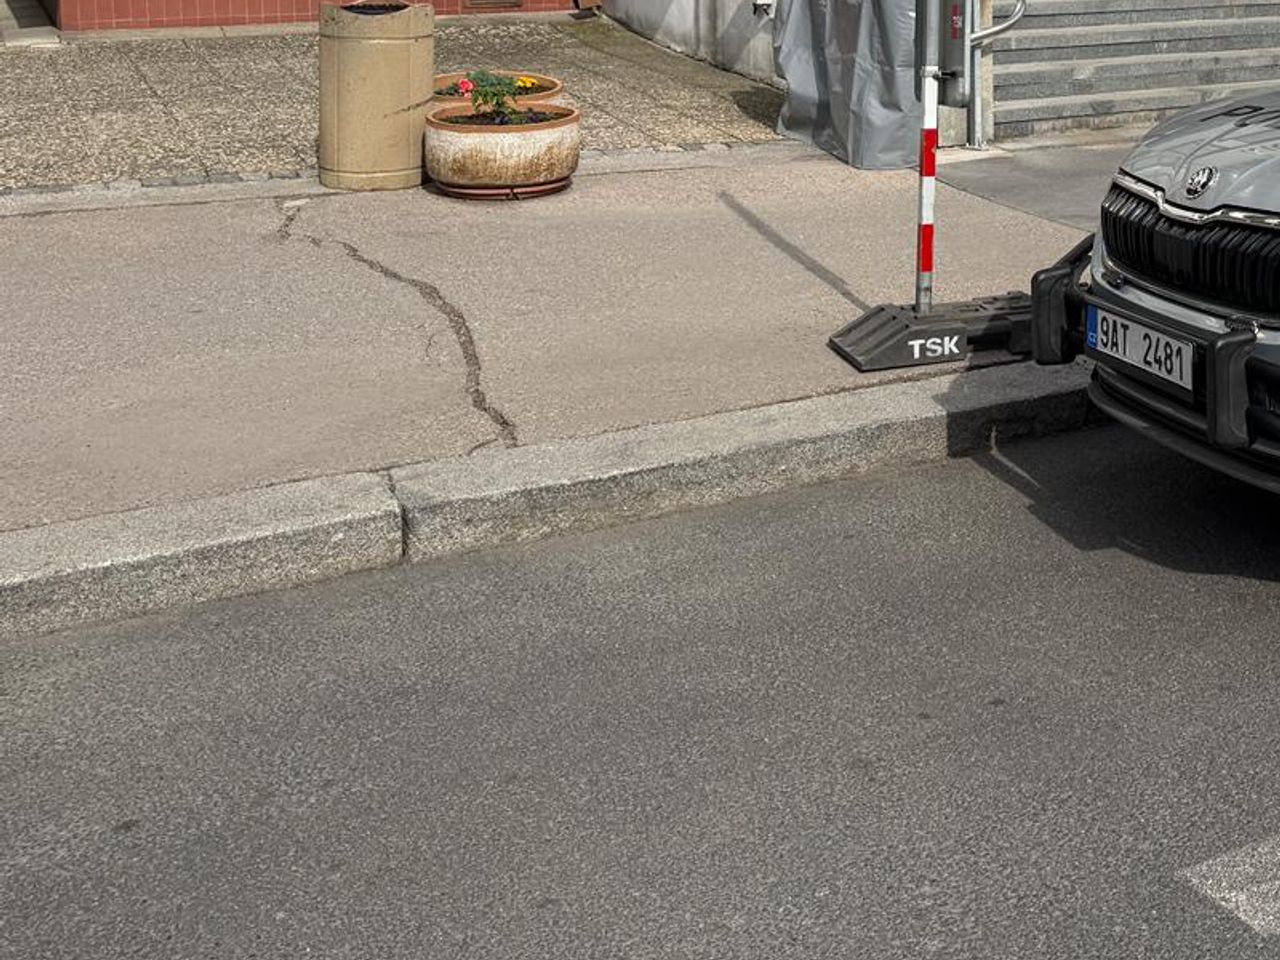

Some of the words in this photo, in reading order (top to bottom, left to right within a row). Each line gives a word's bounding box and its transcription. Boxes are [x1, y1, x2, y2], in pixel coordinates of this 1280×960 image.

[908, 335, 960, 360] TSK
[1100, 316, 1129, 355] 9AT
[1142, 333, 1184, 381] 2481
